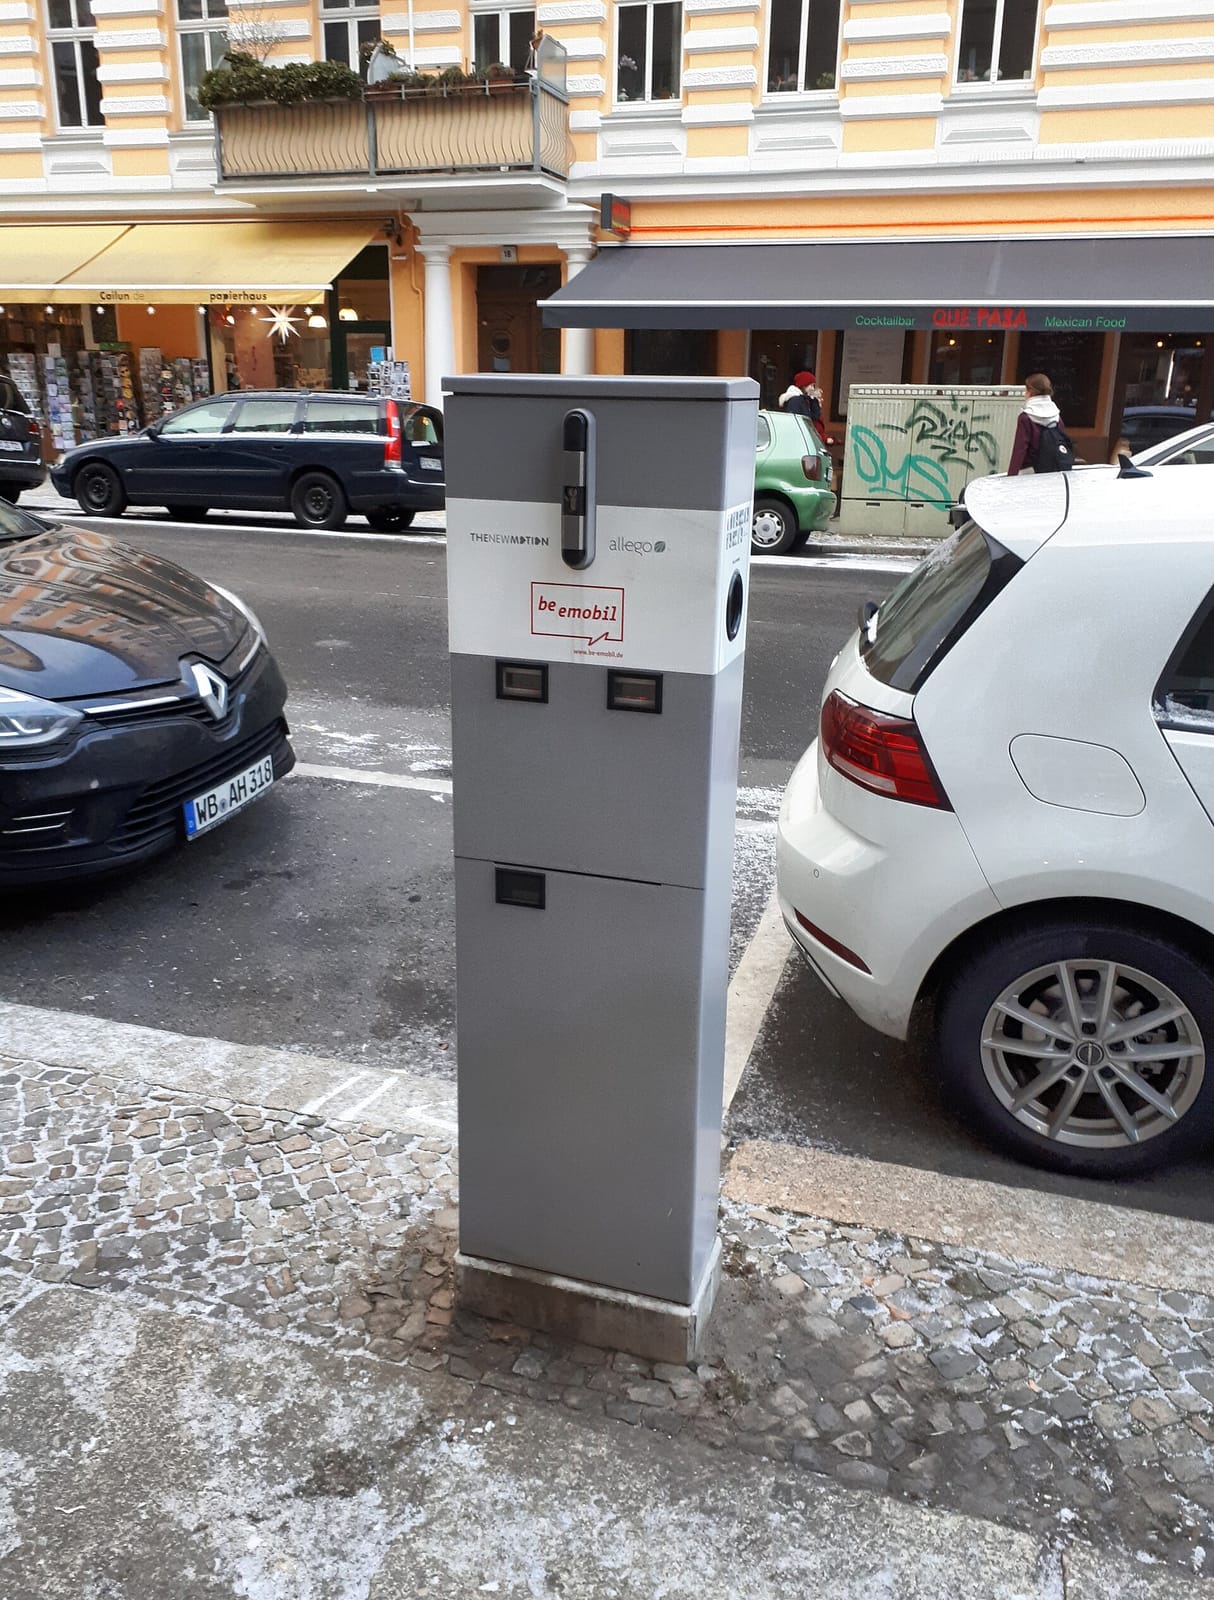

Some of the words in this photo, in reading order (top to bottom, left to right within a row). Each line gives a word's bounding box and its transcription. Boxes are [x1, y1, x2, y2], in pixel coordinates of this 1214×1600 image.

[99, 290, 130, 301] Cailun
[210, 290, 268, 303] papierhaus
[855, 314, 916, 326] Cocktailbar
[932, 307, 972, 328] QUE
[976, 307, 1028, 328] PASA
[1044, 315, 1093, 328] Mexican
[1095, 315, 1126, 328] Food
[609, 536, 653, 557] allego
[538, 595, 557, 612] be
[558, 604, 617, 622] emobil
[196, 793, 219, 825] WB
[229, 775, 248, 808] AH
[249, 760, 272, 793] 318
